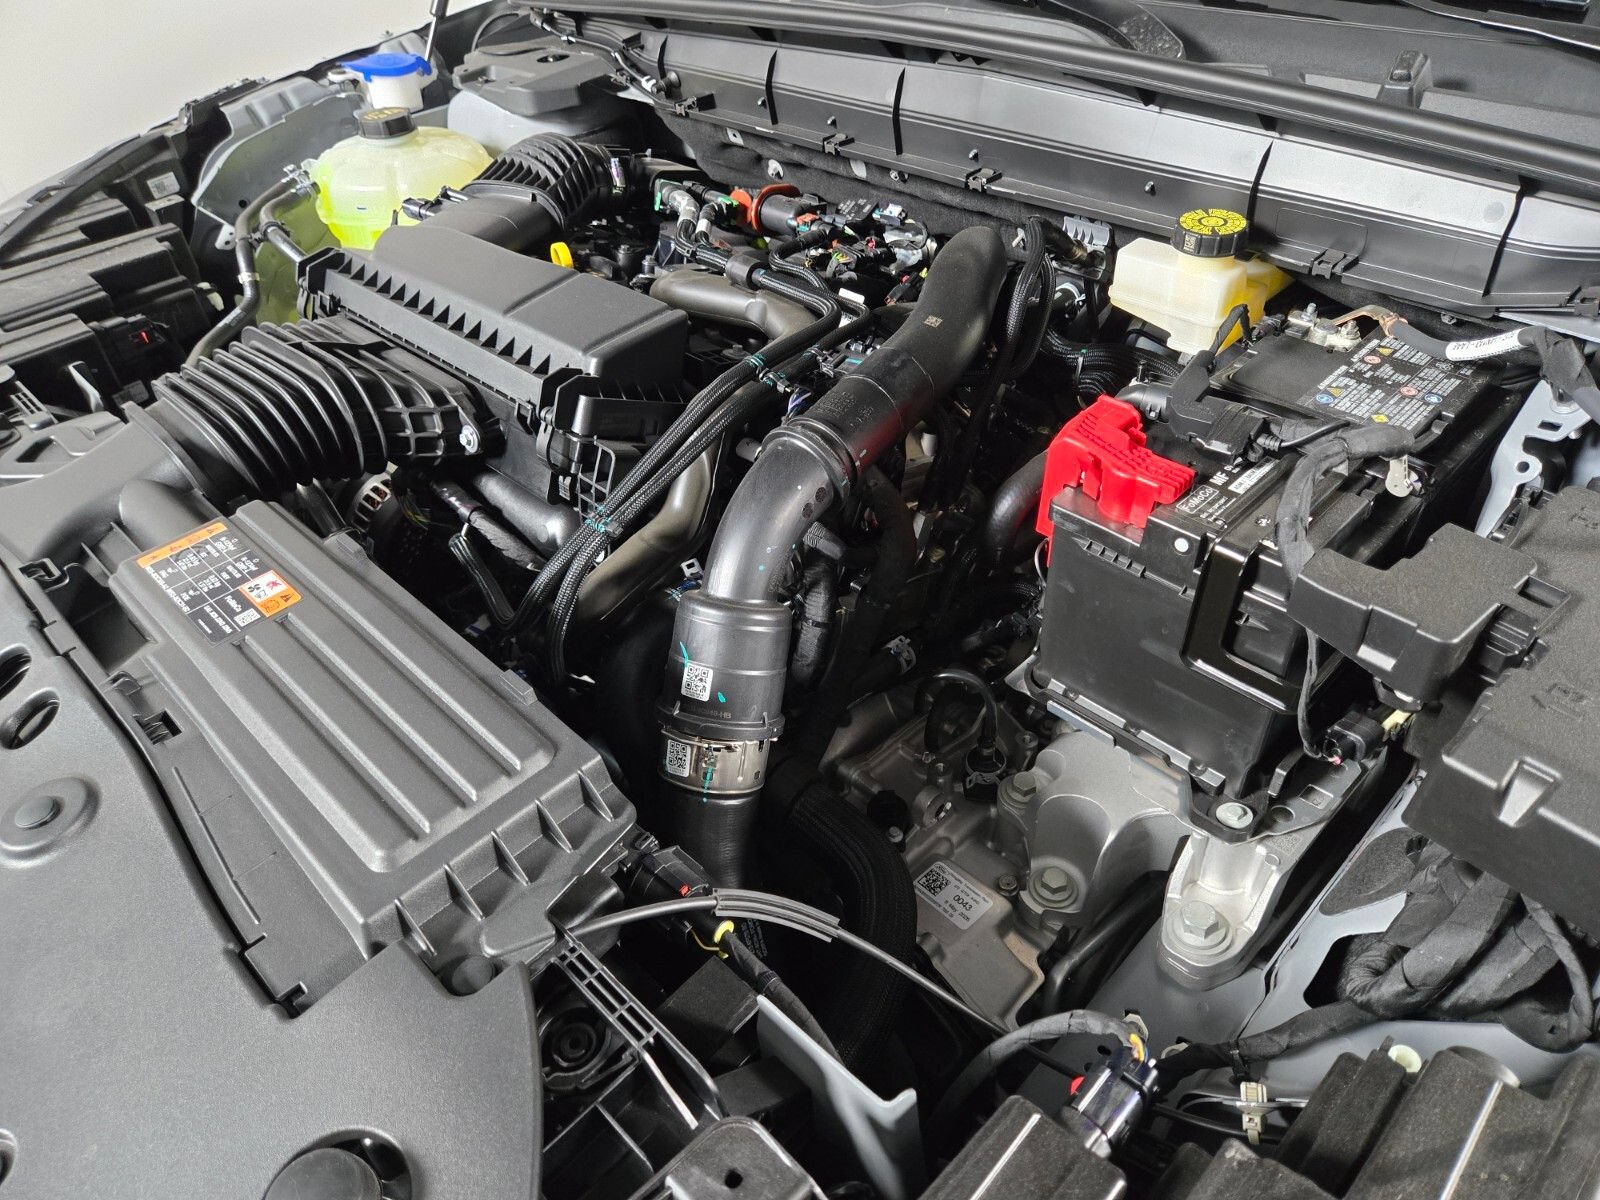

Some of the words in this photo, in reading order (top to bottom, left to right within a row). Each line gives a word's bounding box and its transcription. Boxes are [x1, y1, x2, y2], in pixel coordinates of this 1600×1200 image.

[1209, 471, 1230, 486] MF
[1181, 487, 1214, 512] FoMoCo
[953, 894, 972, 911] 0043
